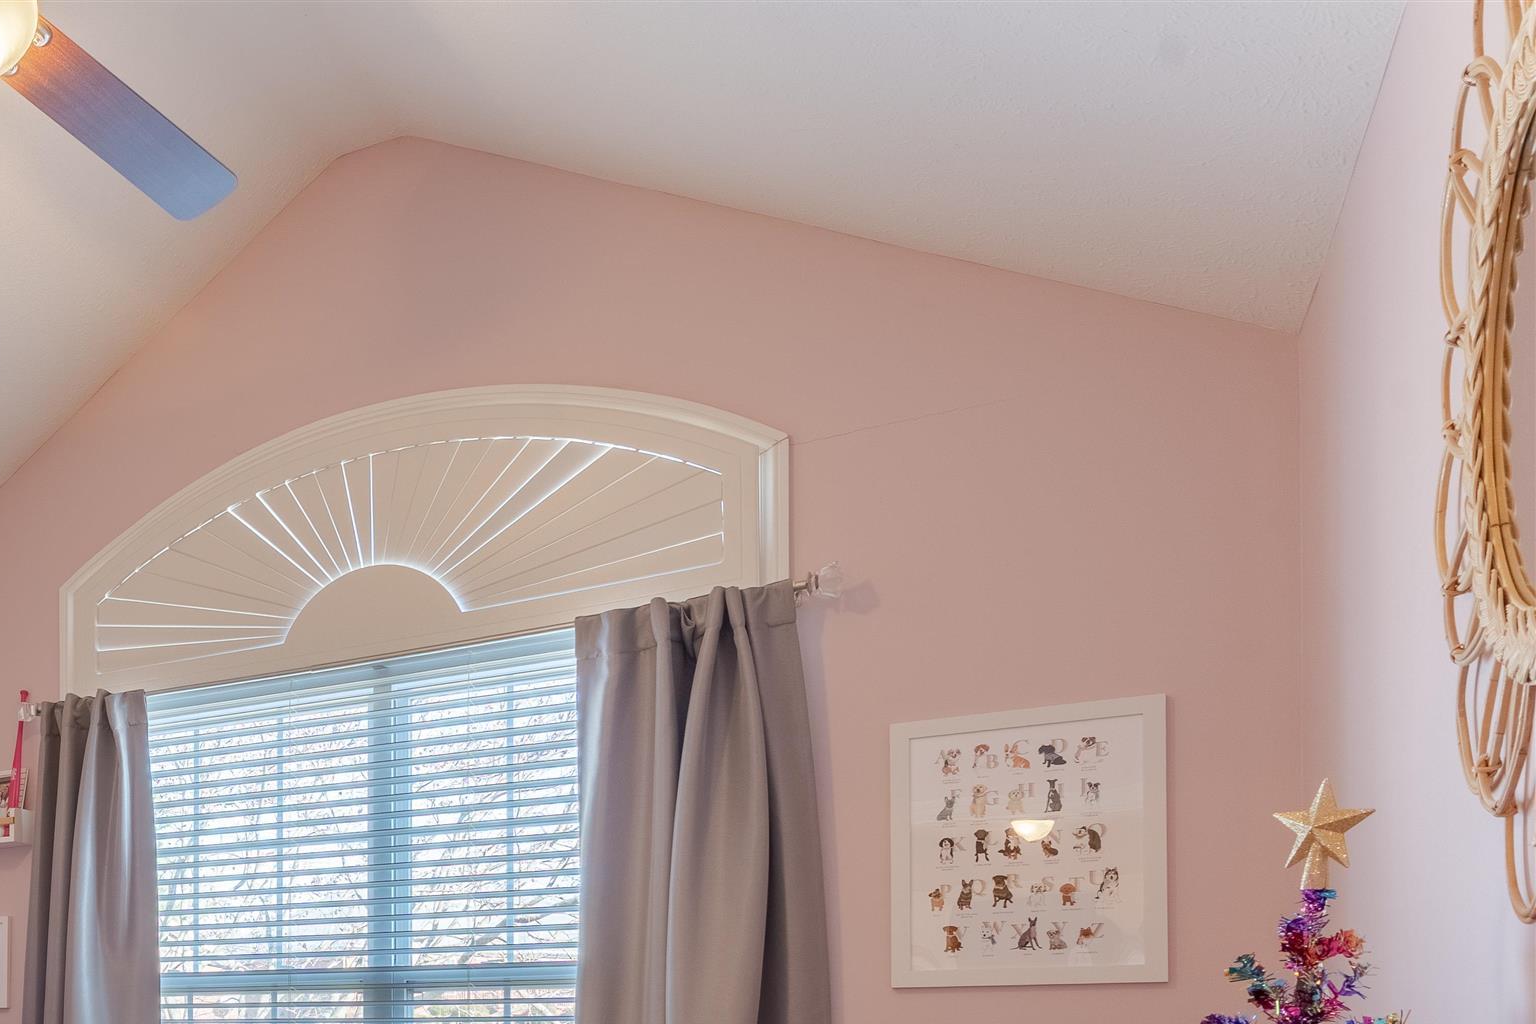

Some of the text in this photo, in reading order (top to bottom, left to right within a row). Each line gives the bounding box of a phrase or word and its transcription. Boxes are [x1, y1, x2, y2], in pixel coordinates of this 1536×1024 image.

[986, 754, 999, 769] B
[1013, 739, 1029, 755] C
[1051, 738, 1067, 753] D
[1096, 741, 1110, 757] E
[1018, 783, 1036, 798] H
[1041, 876, 1054, 892] S
[1068, 876, 1085, 892] T
